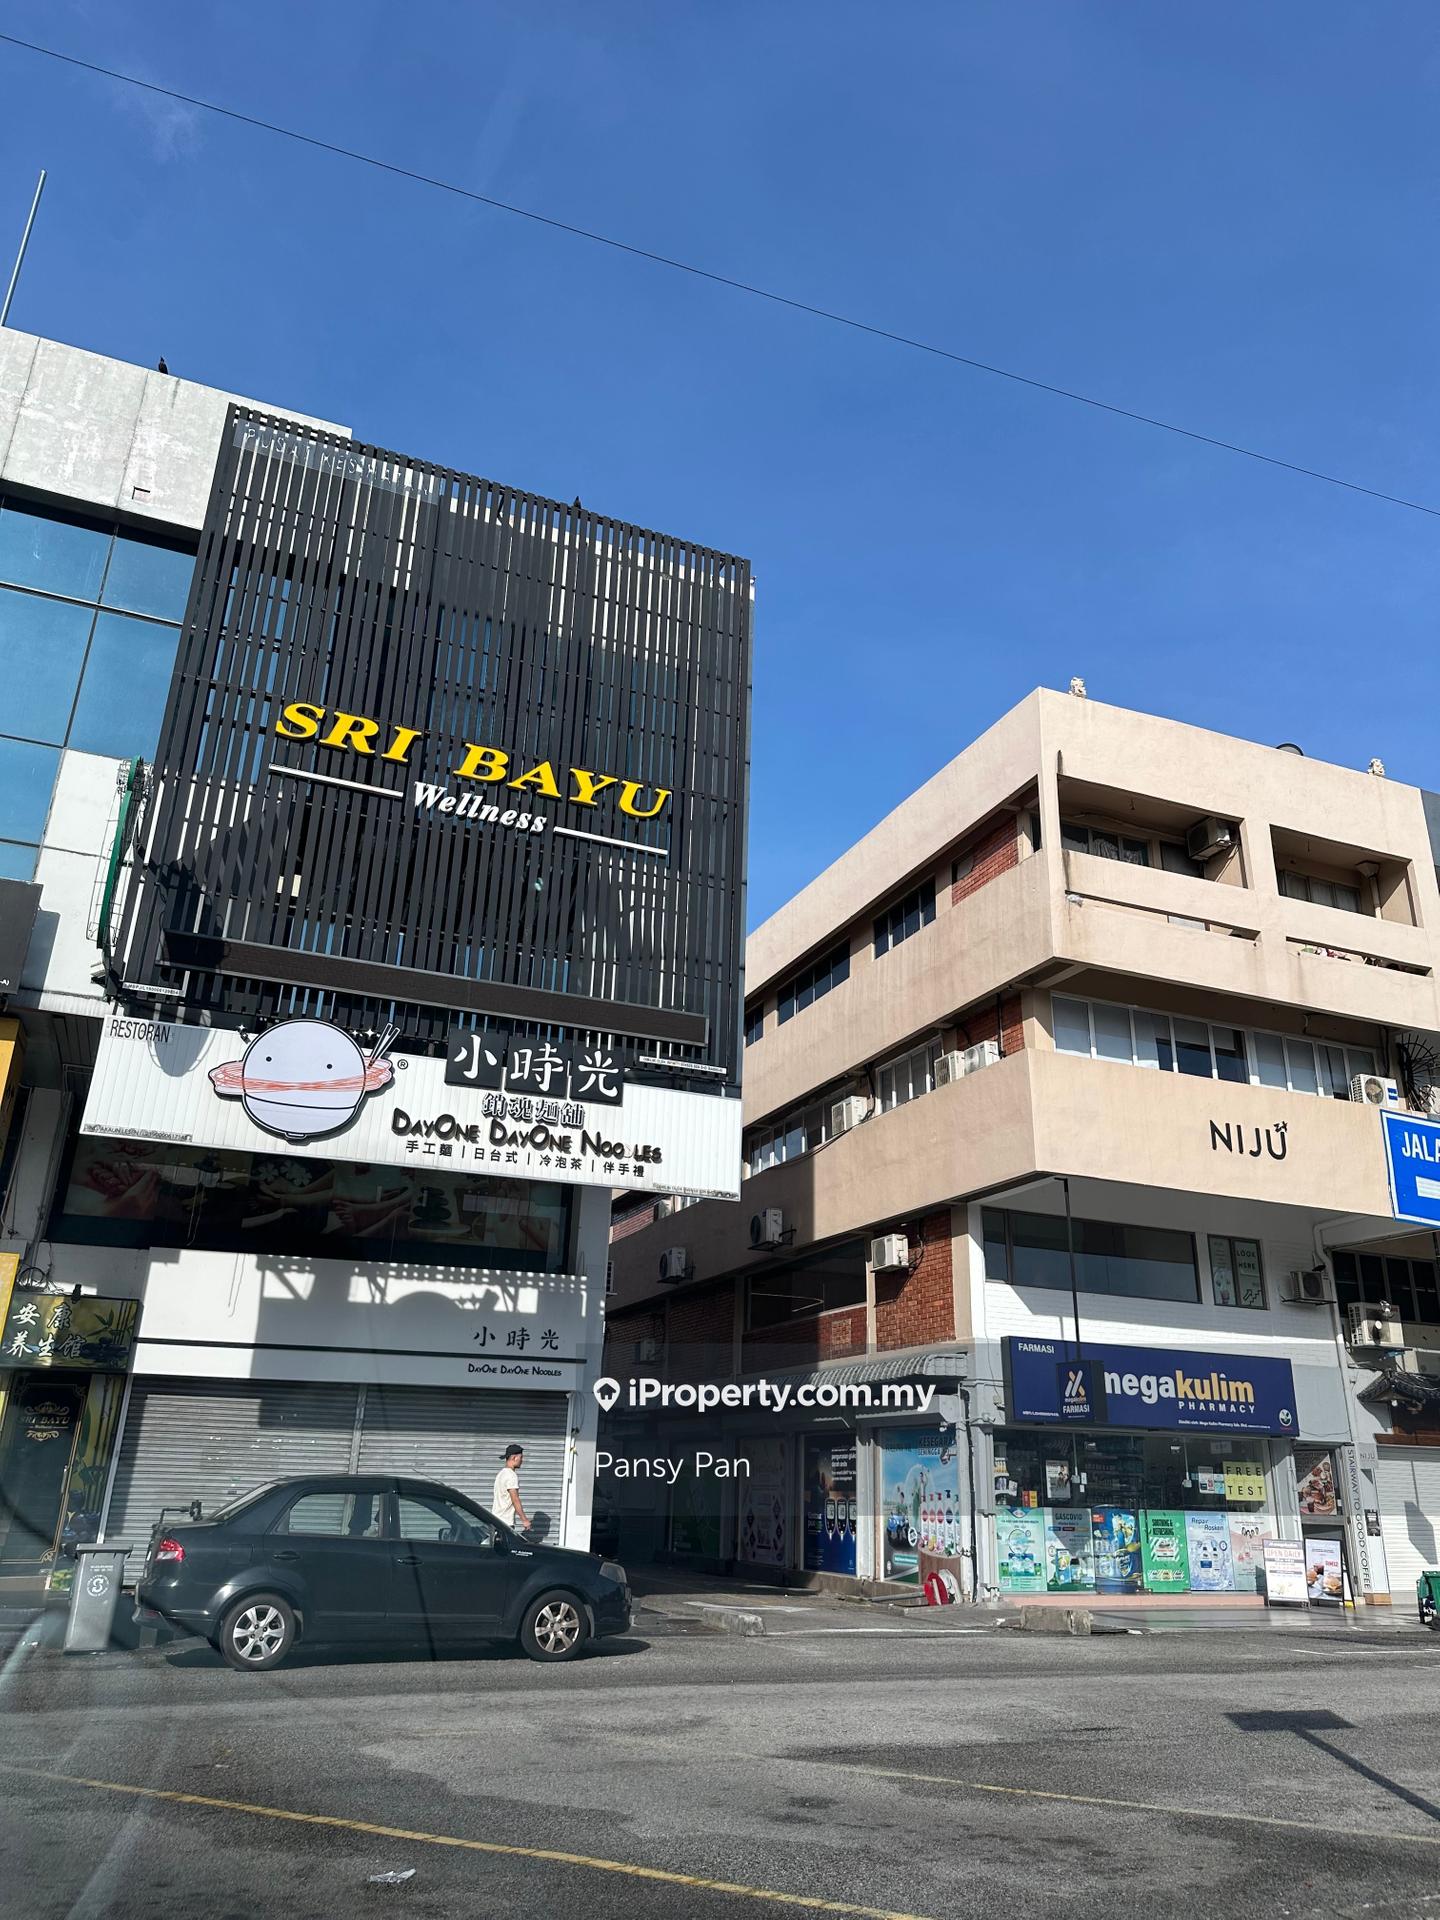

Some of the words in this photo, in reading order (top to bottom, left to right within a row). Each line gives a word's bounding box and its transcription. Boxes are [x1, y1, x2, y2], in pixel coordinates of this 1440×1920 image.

[275, 702, 422, 763] SRI
[454, 743, 672, 818] BAYU
[413, 782, 547, 833] Wellness
[110, 1019, 170, 1043] RESTORAN
[454, 1034, 619, 1098] 小時光
[12, 1303, 72, 1329] 安康
[6, 1330, 86, 1358] 养生馆
[473, 1326, 560, 1350] 小時光
[1018, 1343, 1054, 1354] FARMASI
[1063, 1404, 1090, 1413] FARMASI
[1179, 1401, 1256, 1414] PHARMACY
[41, 1416, 70, 1424] BAYU
[1226, 1466, 1262, 1476] FREE
[1347, 1449, 1360, 1495] STAIRWAY
[1227, 1486, 1263, 1496] TEST
[1353, 1495, 1361, 1511] TO
[1356, 1513, 1367, 1548] GOOD
[1361, 1550, 1372, 1590] COFFEE
